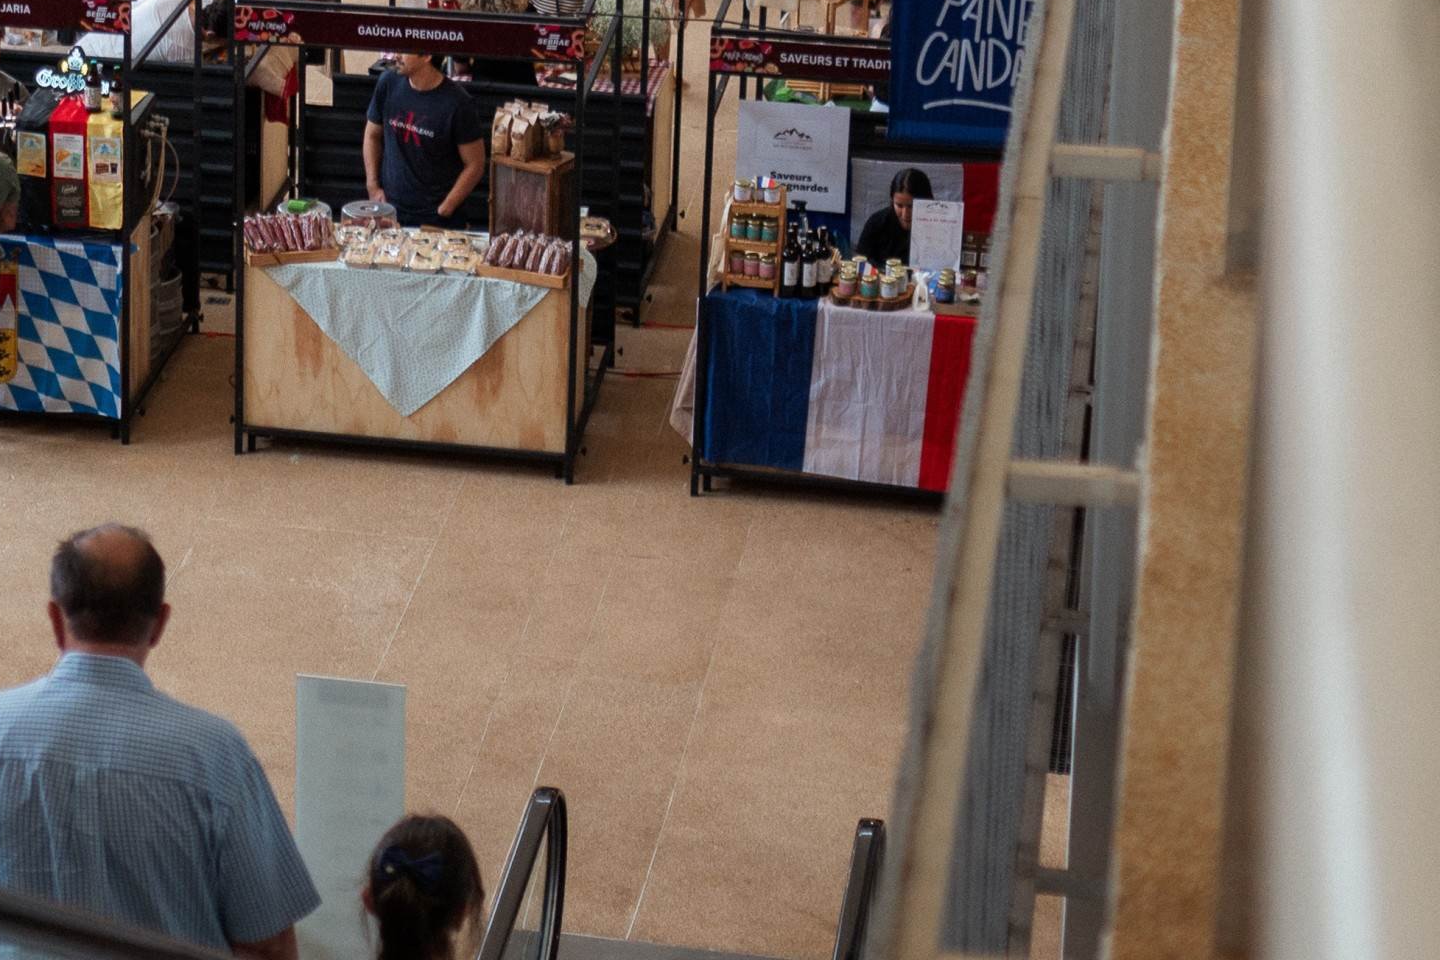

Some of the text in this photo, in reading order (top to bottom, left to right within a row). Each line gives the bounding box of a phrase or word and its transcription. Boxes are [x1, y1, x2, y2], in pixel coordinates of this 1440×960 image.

[358, 24, 464, 42] GAÚCHA PRENDADA
[780, 53, 832, 66] SAVEURS
[835, 56, 849, 67] ET
[770, 171, 812, 182] Saveurs
